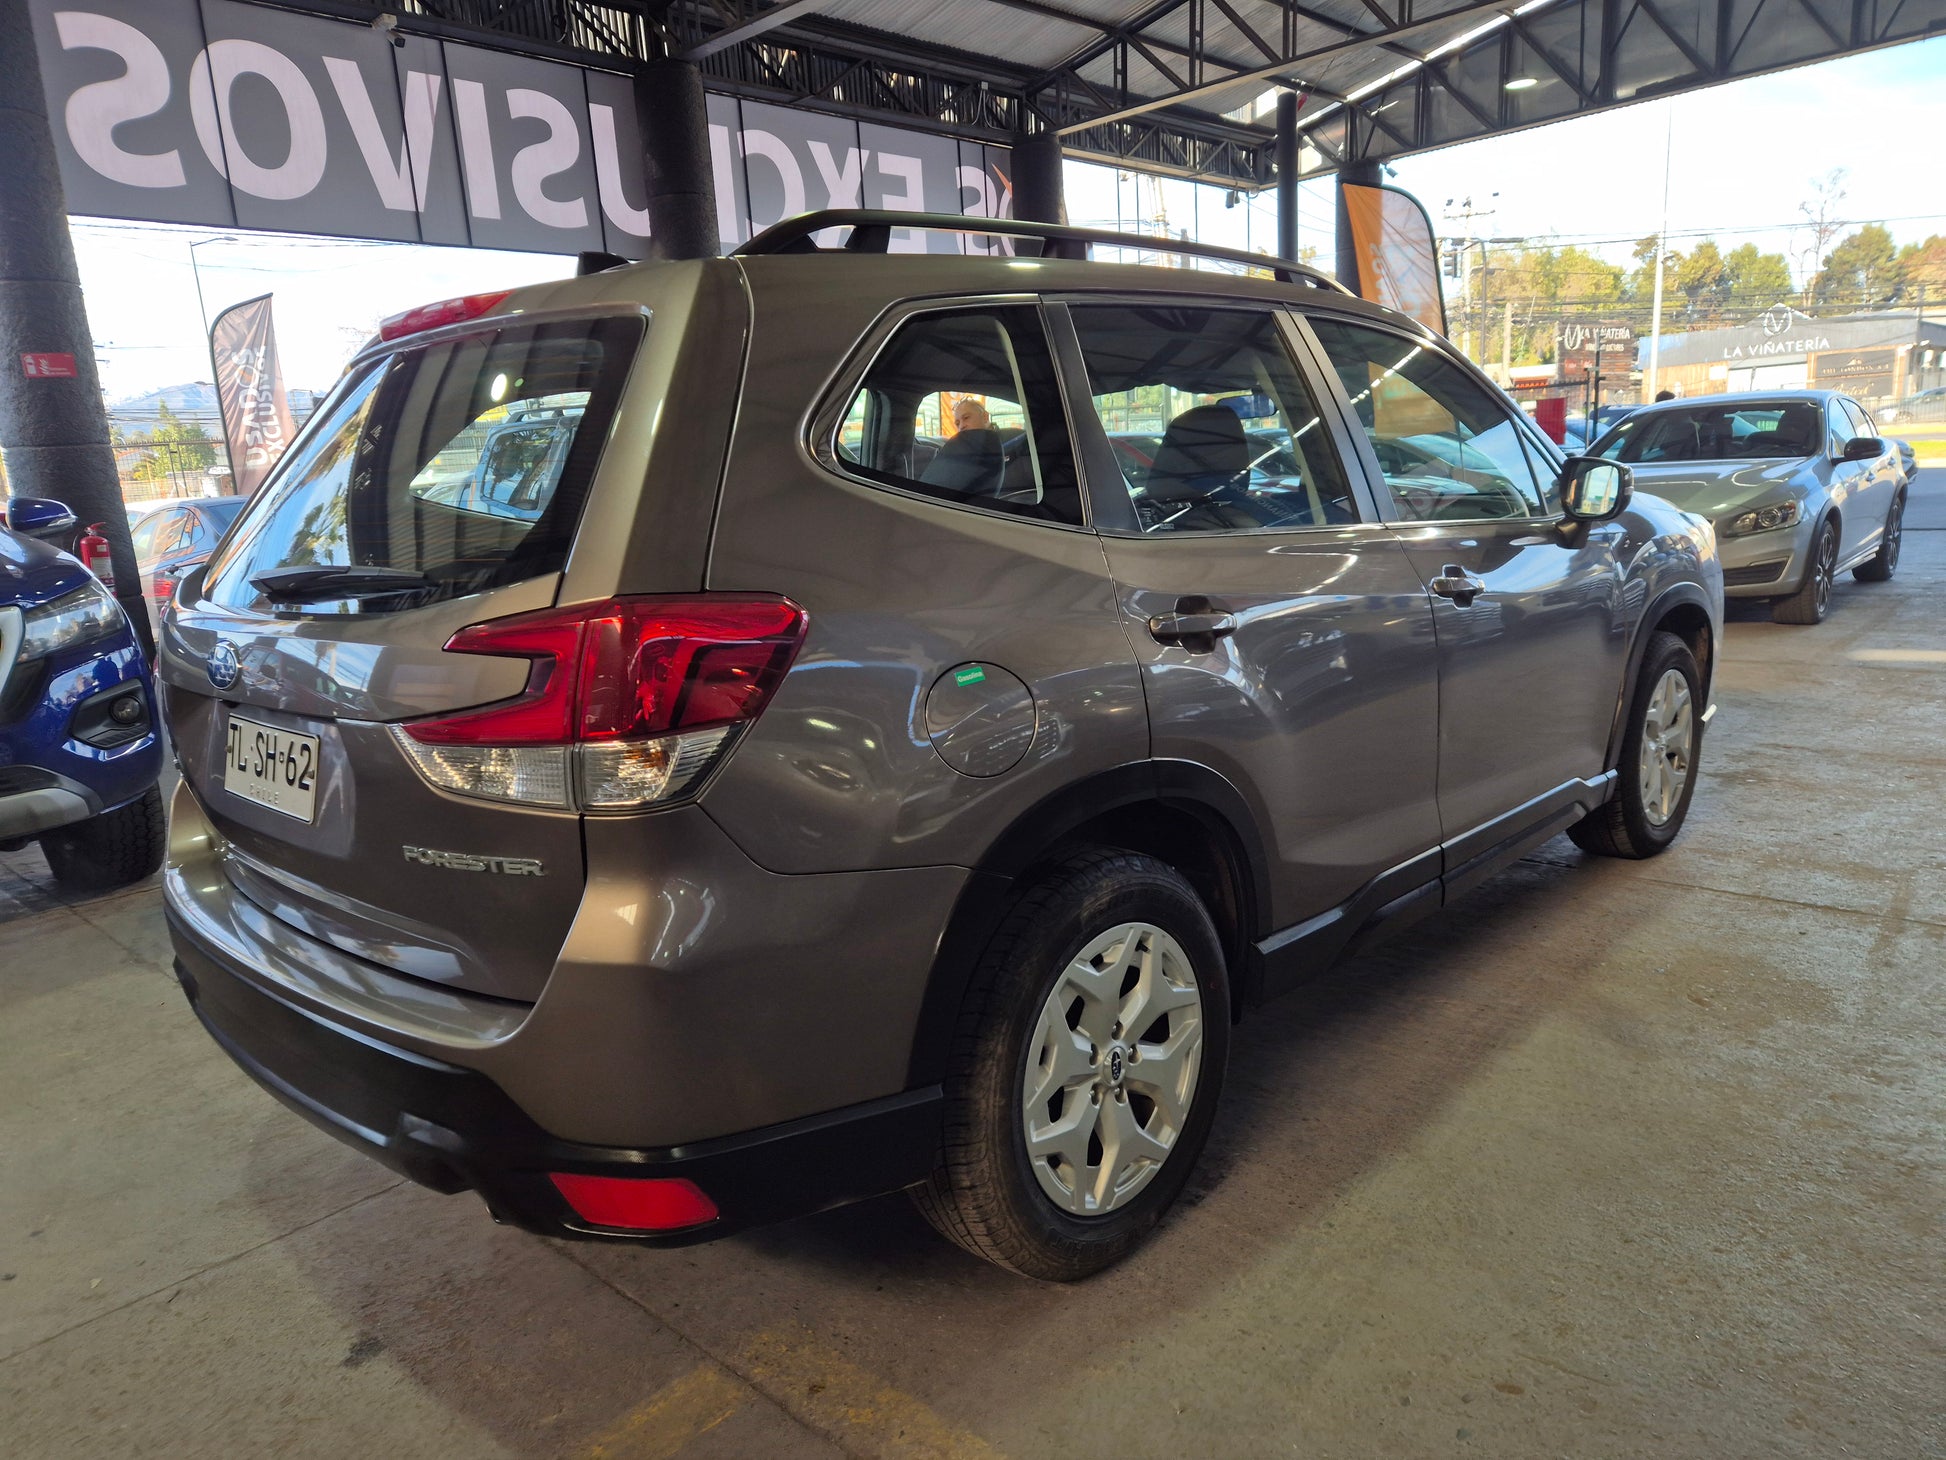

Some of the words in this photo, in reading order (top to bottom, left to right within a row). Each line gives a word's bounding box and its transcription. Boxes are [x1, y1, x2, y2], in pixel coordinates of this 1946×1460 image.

[1593, 326, 1631, 339] VÑATERÍA
[1723, 346, 1743, 359] LA
[1748, 336, 1830, 355] VIÑATERÍA
[231, 348, 268, 469] USADOS
[957, 671, 984, 682] Gasolina
[402, 845, 545, 877] FORESTER
